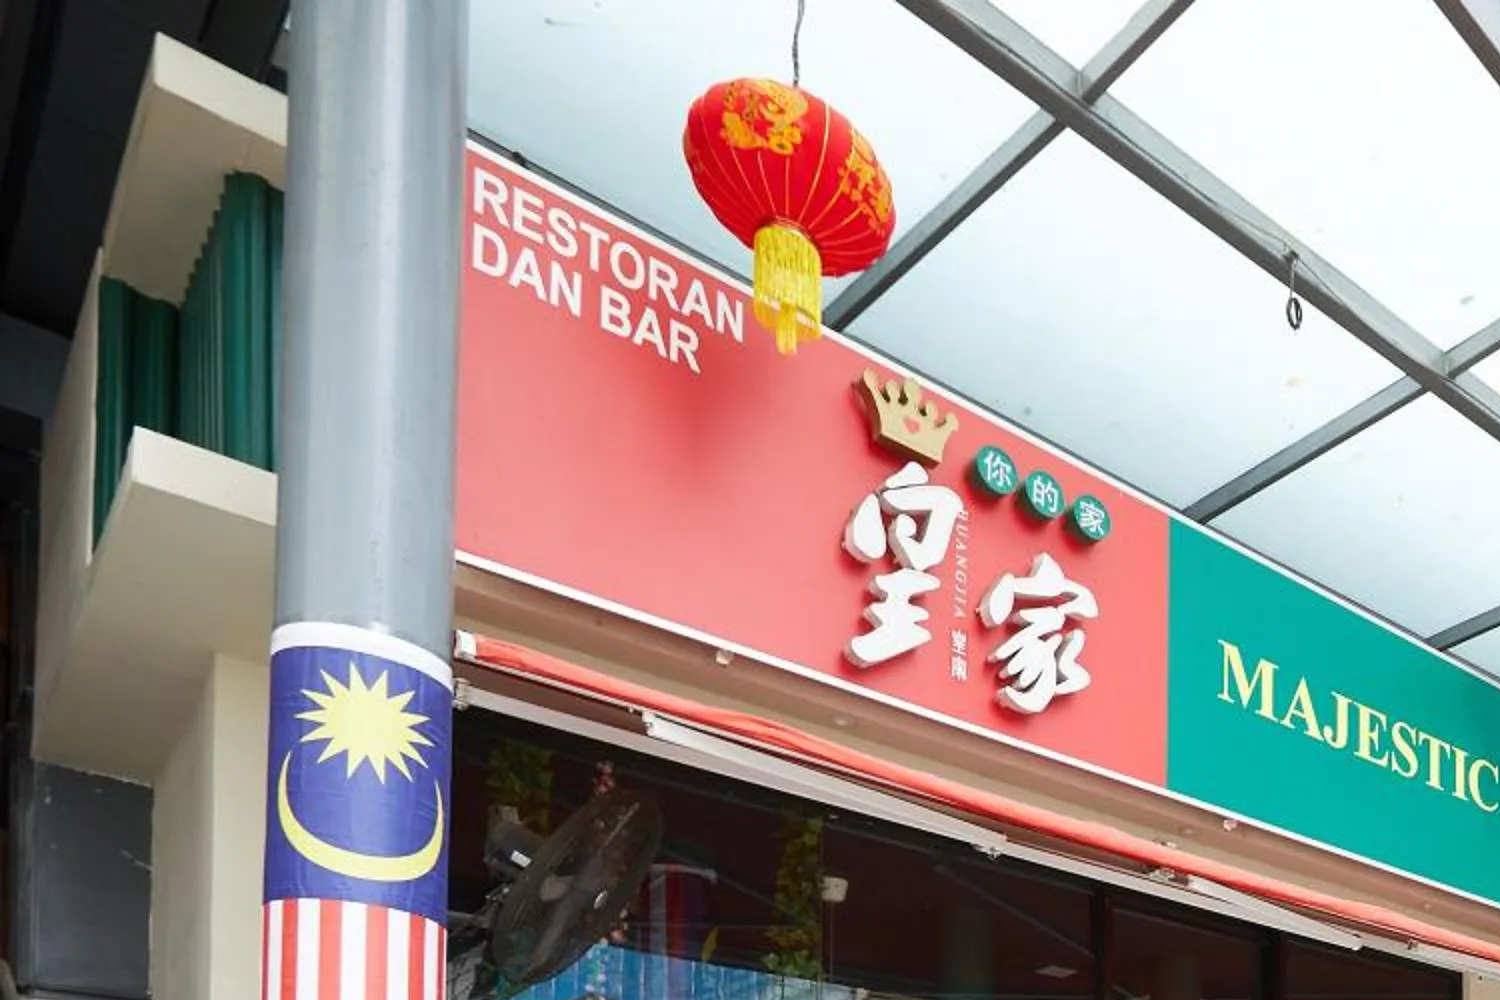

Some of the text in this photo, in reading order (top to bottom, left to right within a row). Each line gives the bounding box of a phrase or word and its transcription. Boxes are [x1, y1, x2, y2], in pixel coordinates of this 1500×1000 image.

[472, 222, 701, 374] DAN BAR
[473, 167, 743, 343] RESTORAN
[982, 450, 1105, 536] 你的家
[840, 460, 1099, 714] 皇家
[1217, 639, 1499, 812] MAJESTIC
